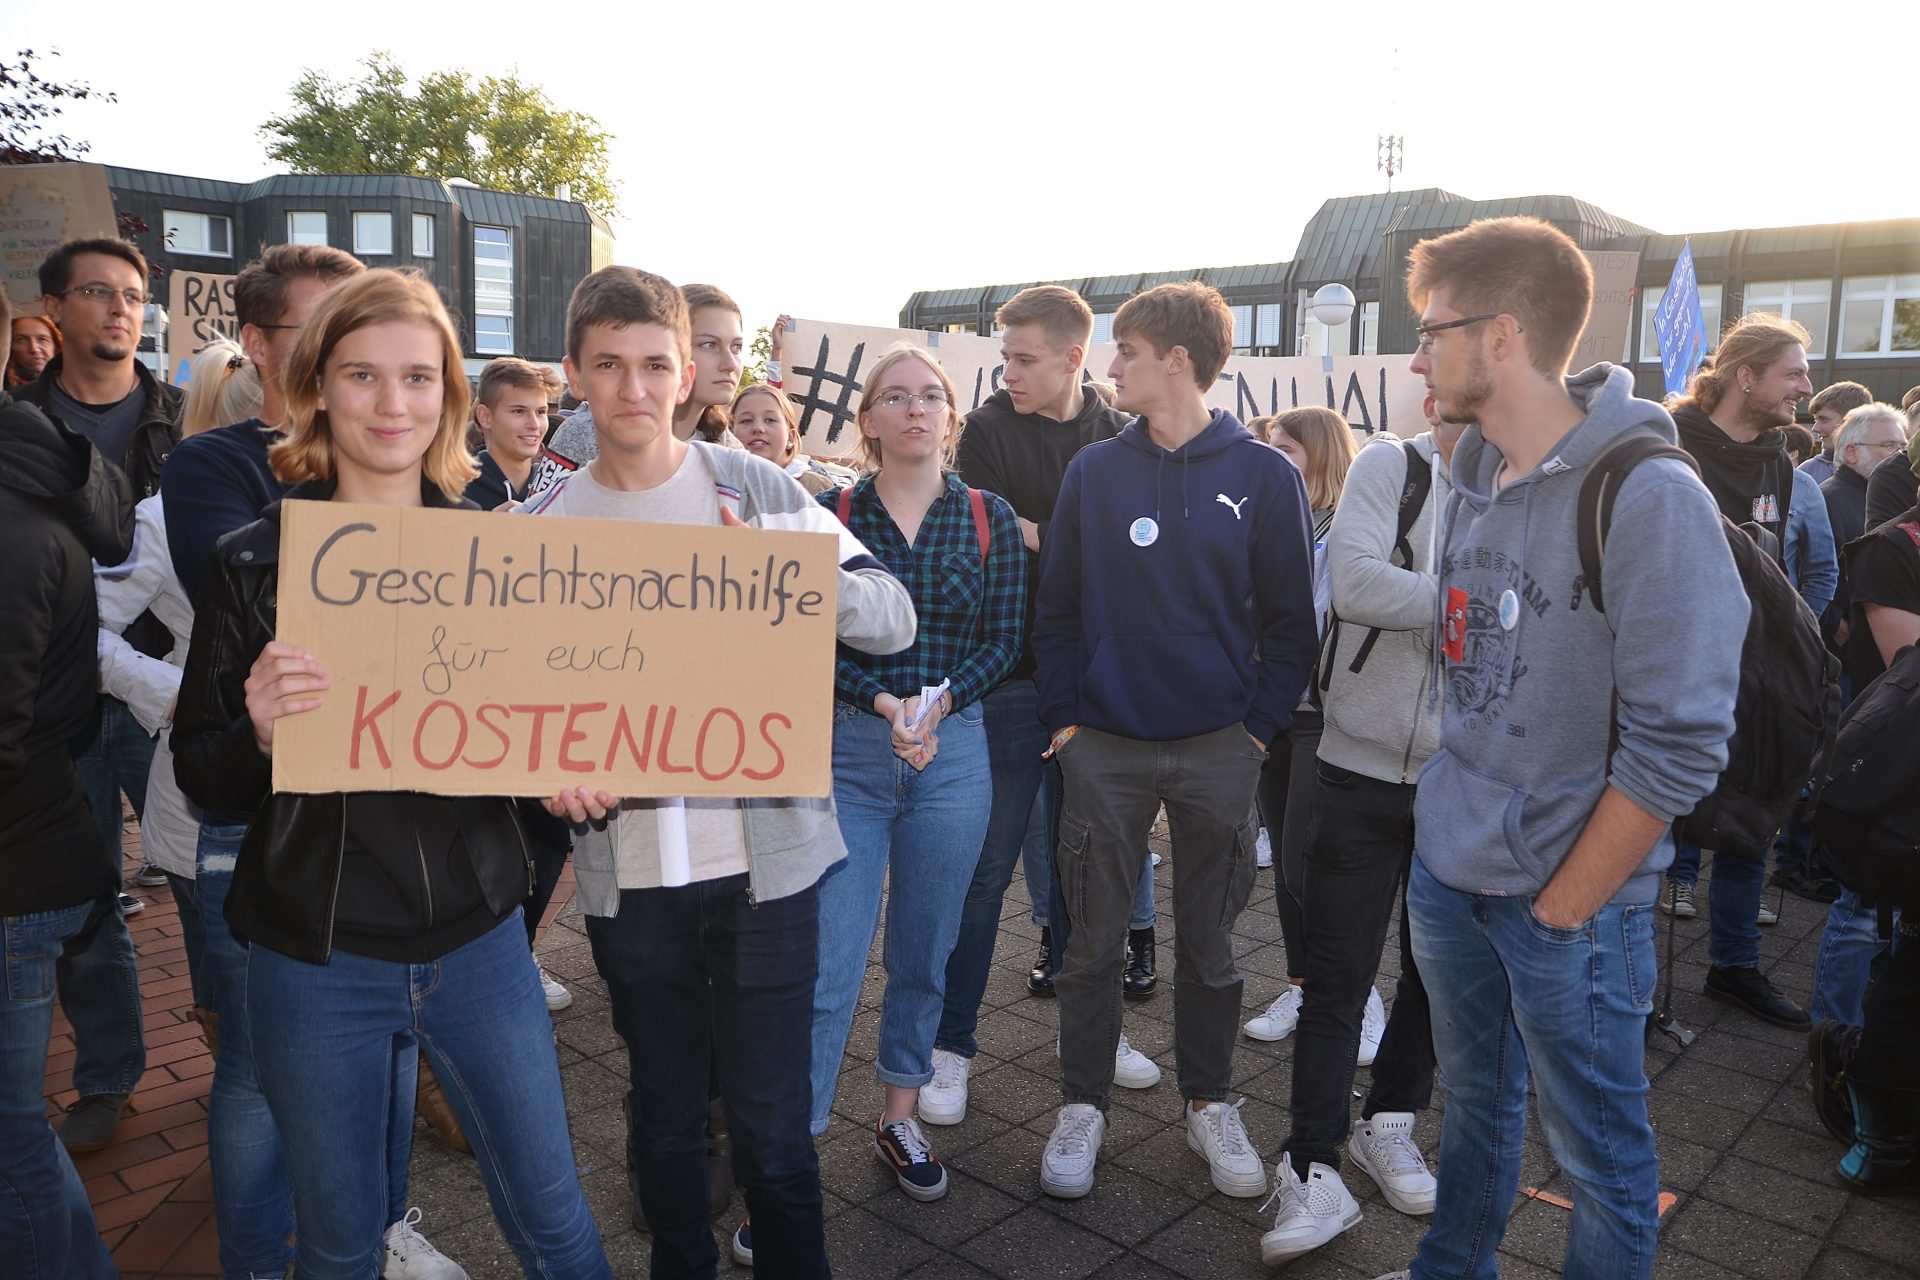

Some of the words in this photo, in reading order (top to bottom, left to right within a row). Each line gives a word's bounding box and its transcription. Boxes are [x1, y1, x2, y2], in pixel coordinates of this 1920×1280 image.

[310, 522, 823, 627] Geschichtsnachhilfe
[421, 625, 508, 695] für
[546, 627, 645, 673] euch
[348, 685, 793, 781] KOSTENLOS
